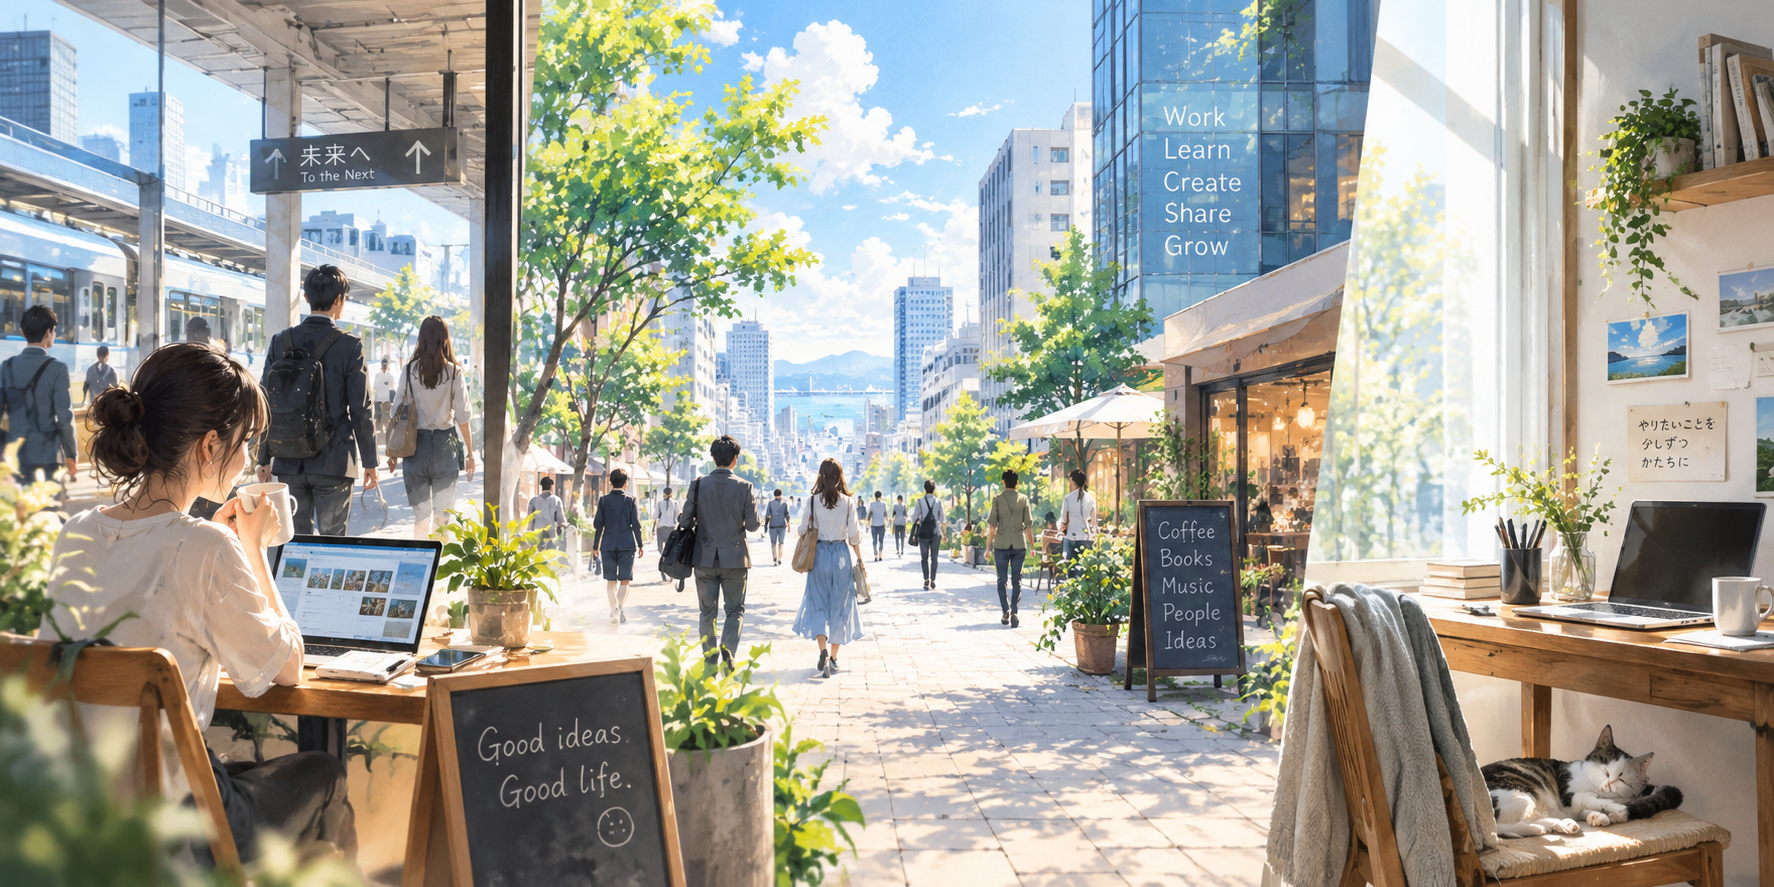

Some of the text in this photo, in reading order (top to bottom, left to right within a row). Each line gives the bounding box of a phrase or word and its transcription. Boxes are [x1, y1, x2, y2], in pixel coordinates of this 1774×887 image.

[1163, 105, 1226, 127] Work
[300, 143, 371, 167] 未来へ
[1164, 137, 1231, 160] Learn
[300, 168, 375, 183] To the Next
[1163, 170, 1242, 192] Create
[1164, 202, 1232, 223] Share
[1164, 234, 1229, 256] Grow
[1638, 416, 1716, 432] やりたいことを
[1642, 435, 1689, 451] 少しずつ
[1641, 455, 1689, 469] かたちに
[1158, 520, 1216, 543] Coffee
[1160, 548, 1214, 568] Books
[1162, 576, 1215, 595] Music
[1163, 602, 1222, 627] People
[1164, 629, 1218, 650] Ideas
[477, 721, 546, 767] Good
[499, 760, 632, 810] Good life.
